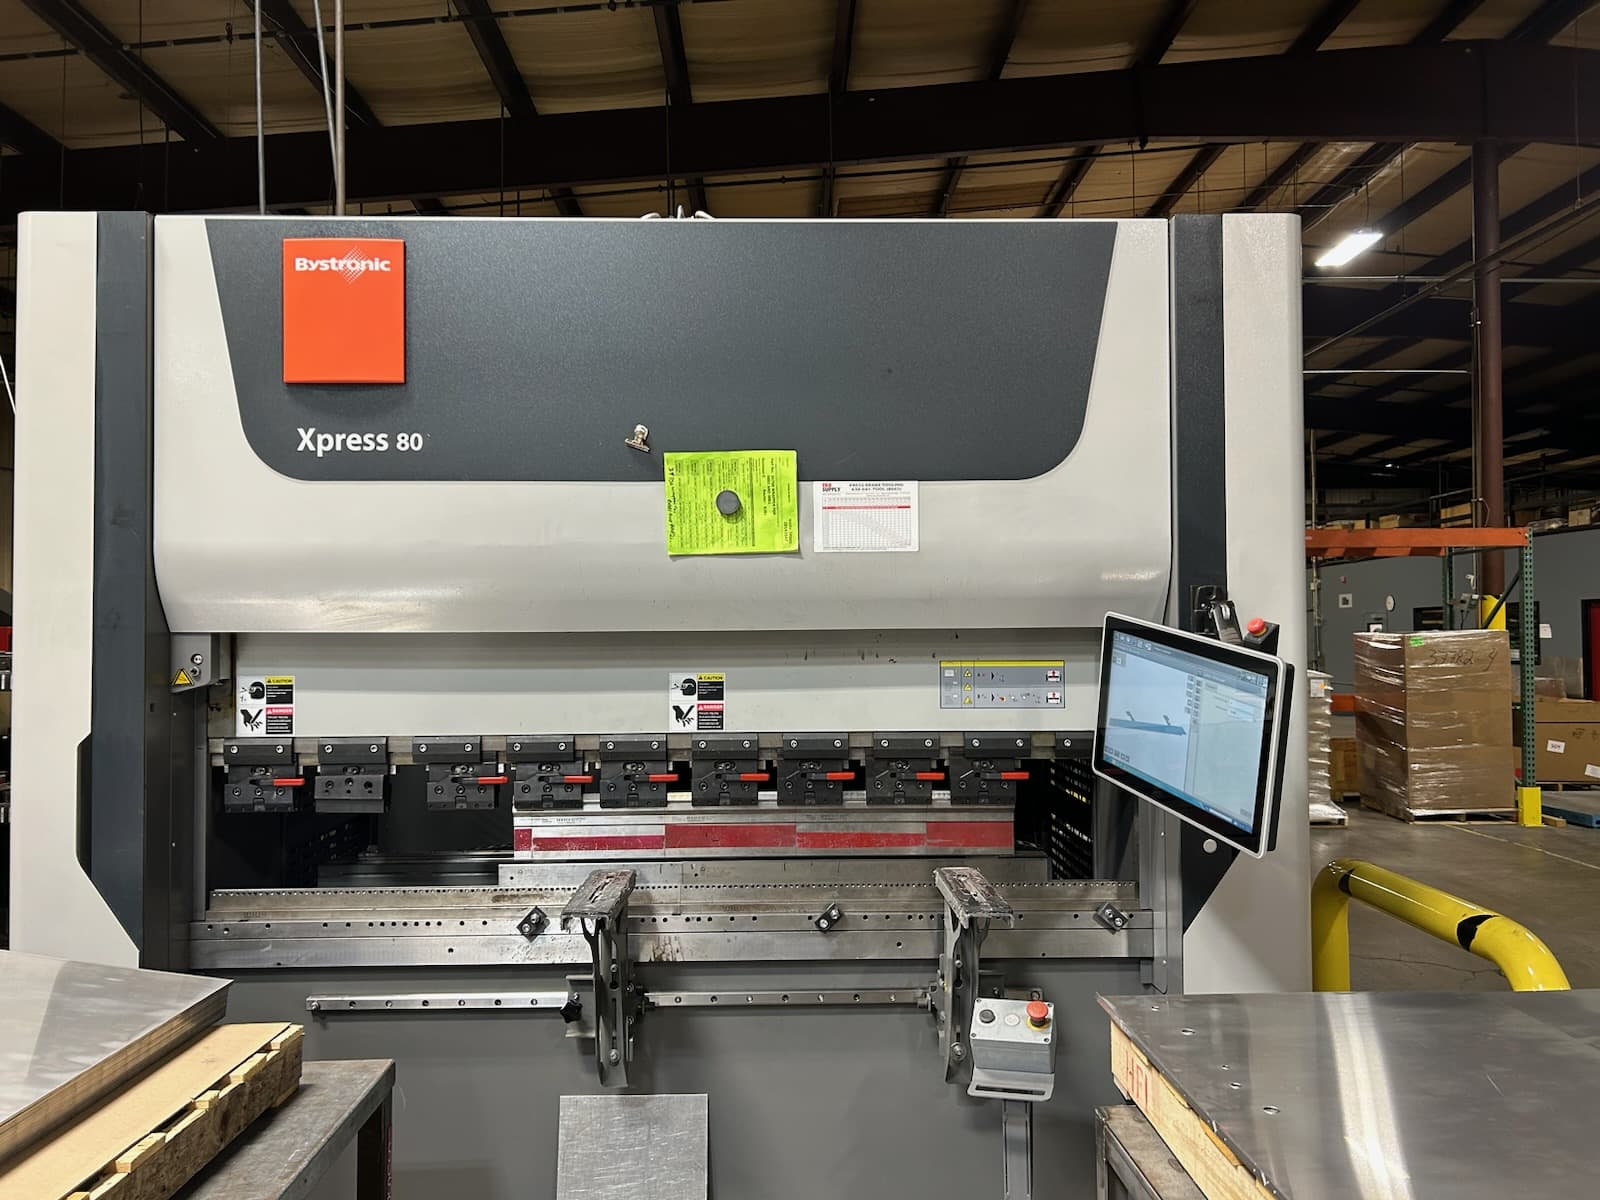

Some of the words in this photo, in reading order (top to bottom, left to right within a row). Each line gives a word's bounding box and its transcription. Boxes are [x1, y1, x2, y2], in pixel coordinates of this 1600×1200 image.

[294, 257, 391, 272] Bystronic
[296, 427, 389, 457] Xpress
[396, 432, 424, 451] 80
